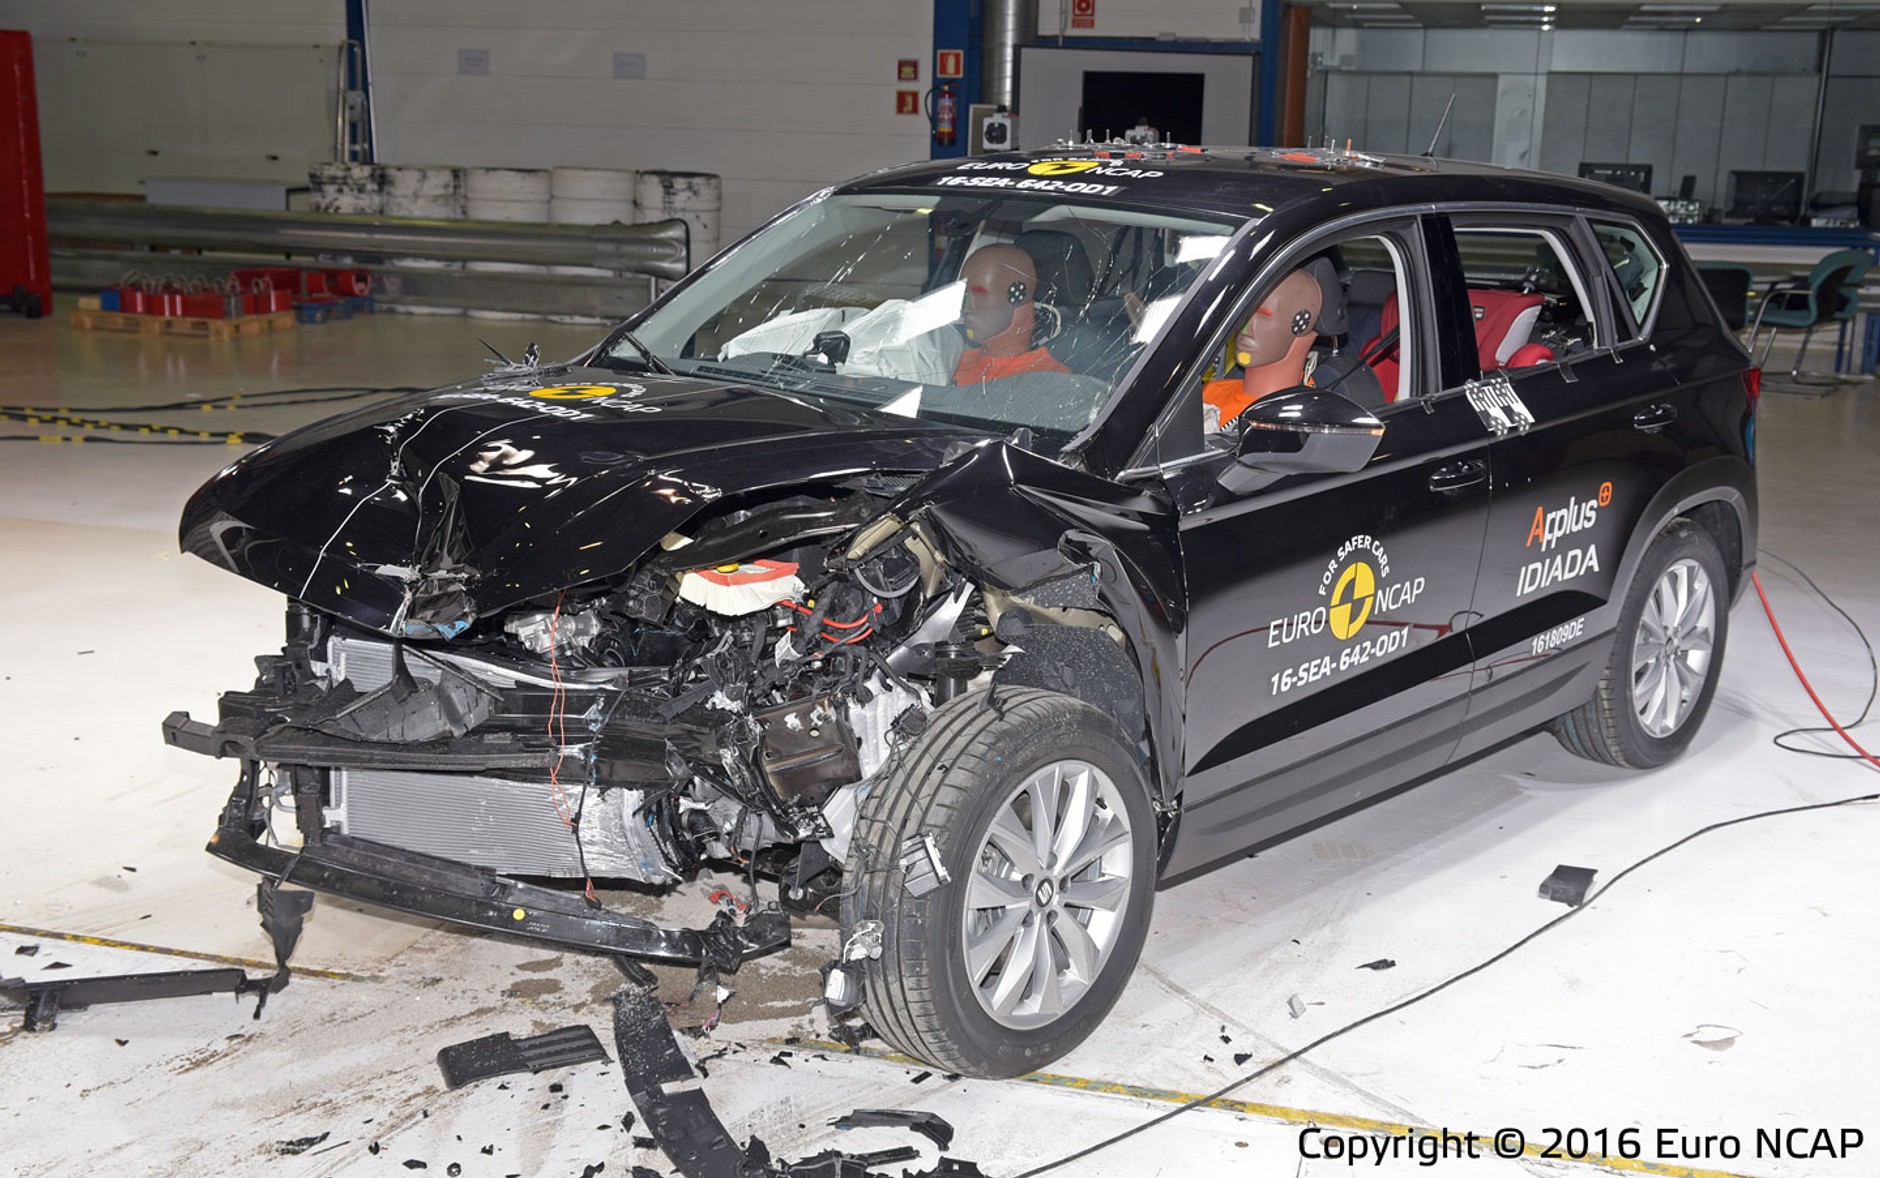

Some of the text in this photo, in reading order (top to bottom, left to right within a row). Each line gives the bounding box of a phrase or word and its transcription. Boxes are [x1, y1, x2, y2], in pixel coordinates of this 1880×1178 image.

[1085, 165, 1164, 179] NCAP
[1318, 534, 1390, 596] FOR SAFER CARS
[1516, 544, 1600, 597] IDIADA
[1267, 577, 1425, 648] EURO NCAP
[1531, 617, 1585, 656] 161809DE
